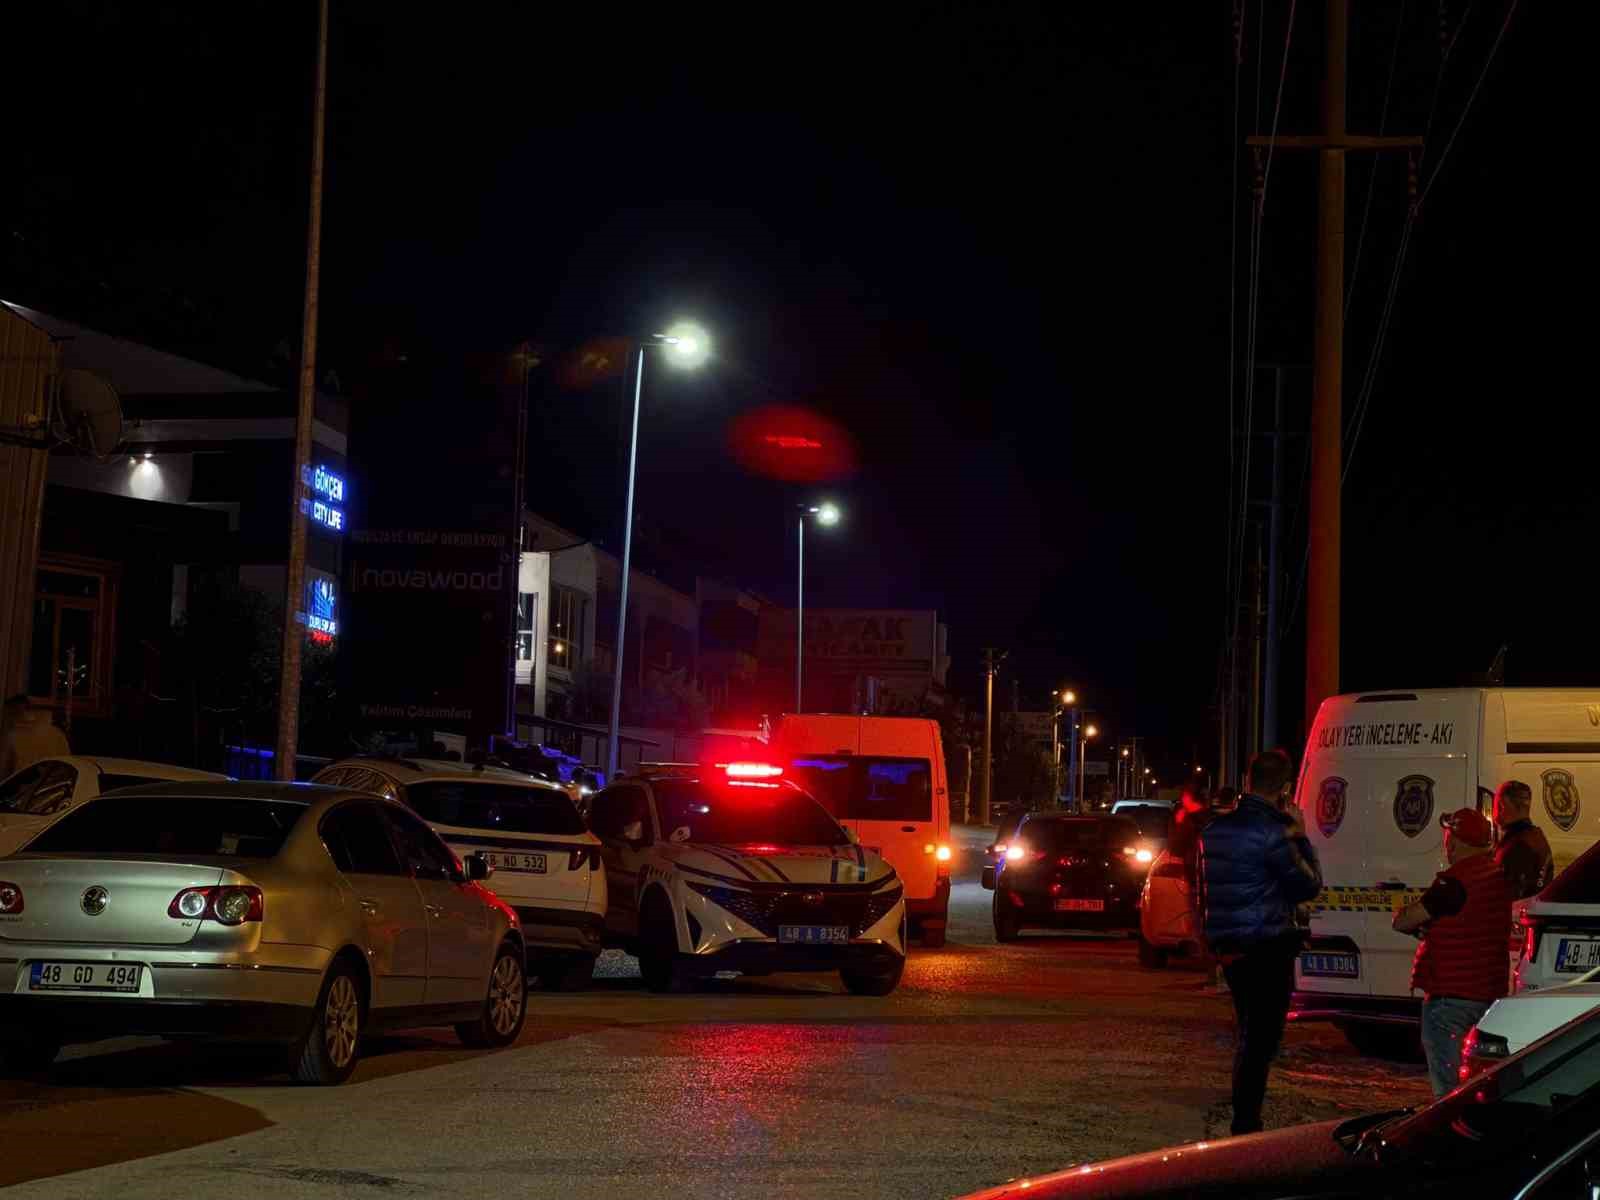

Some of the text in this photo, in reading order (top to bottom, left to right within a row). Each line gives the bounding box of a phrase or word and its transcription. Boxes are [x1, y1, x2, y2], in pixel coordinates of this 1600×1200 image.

[315, 465, 343, 501] GÖKÇEN
[314, 502, 330, 524] CITY
[328, 509, 342, 529] LIFE
[360, 565, 503, 591] novawood
[1319, 726, 1342, 748] OLAY
[1343, 722, 1366, 747] YERİ
[1367, 720, 1422, 745] İNCELEME
[1430, 721, 1455, 745] AKİ
[524, 855, 544, 869] 532
[786, 927, 800, 939] 48
[42, 965, 137, 985] 48 GD 494
